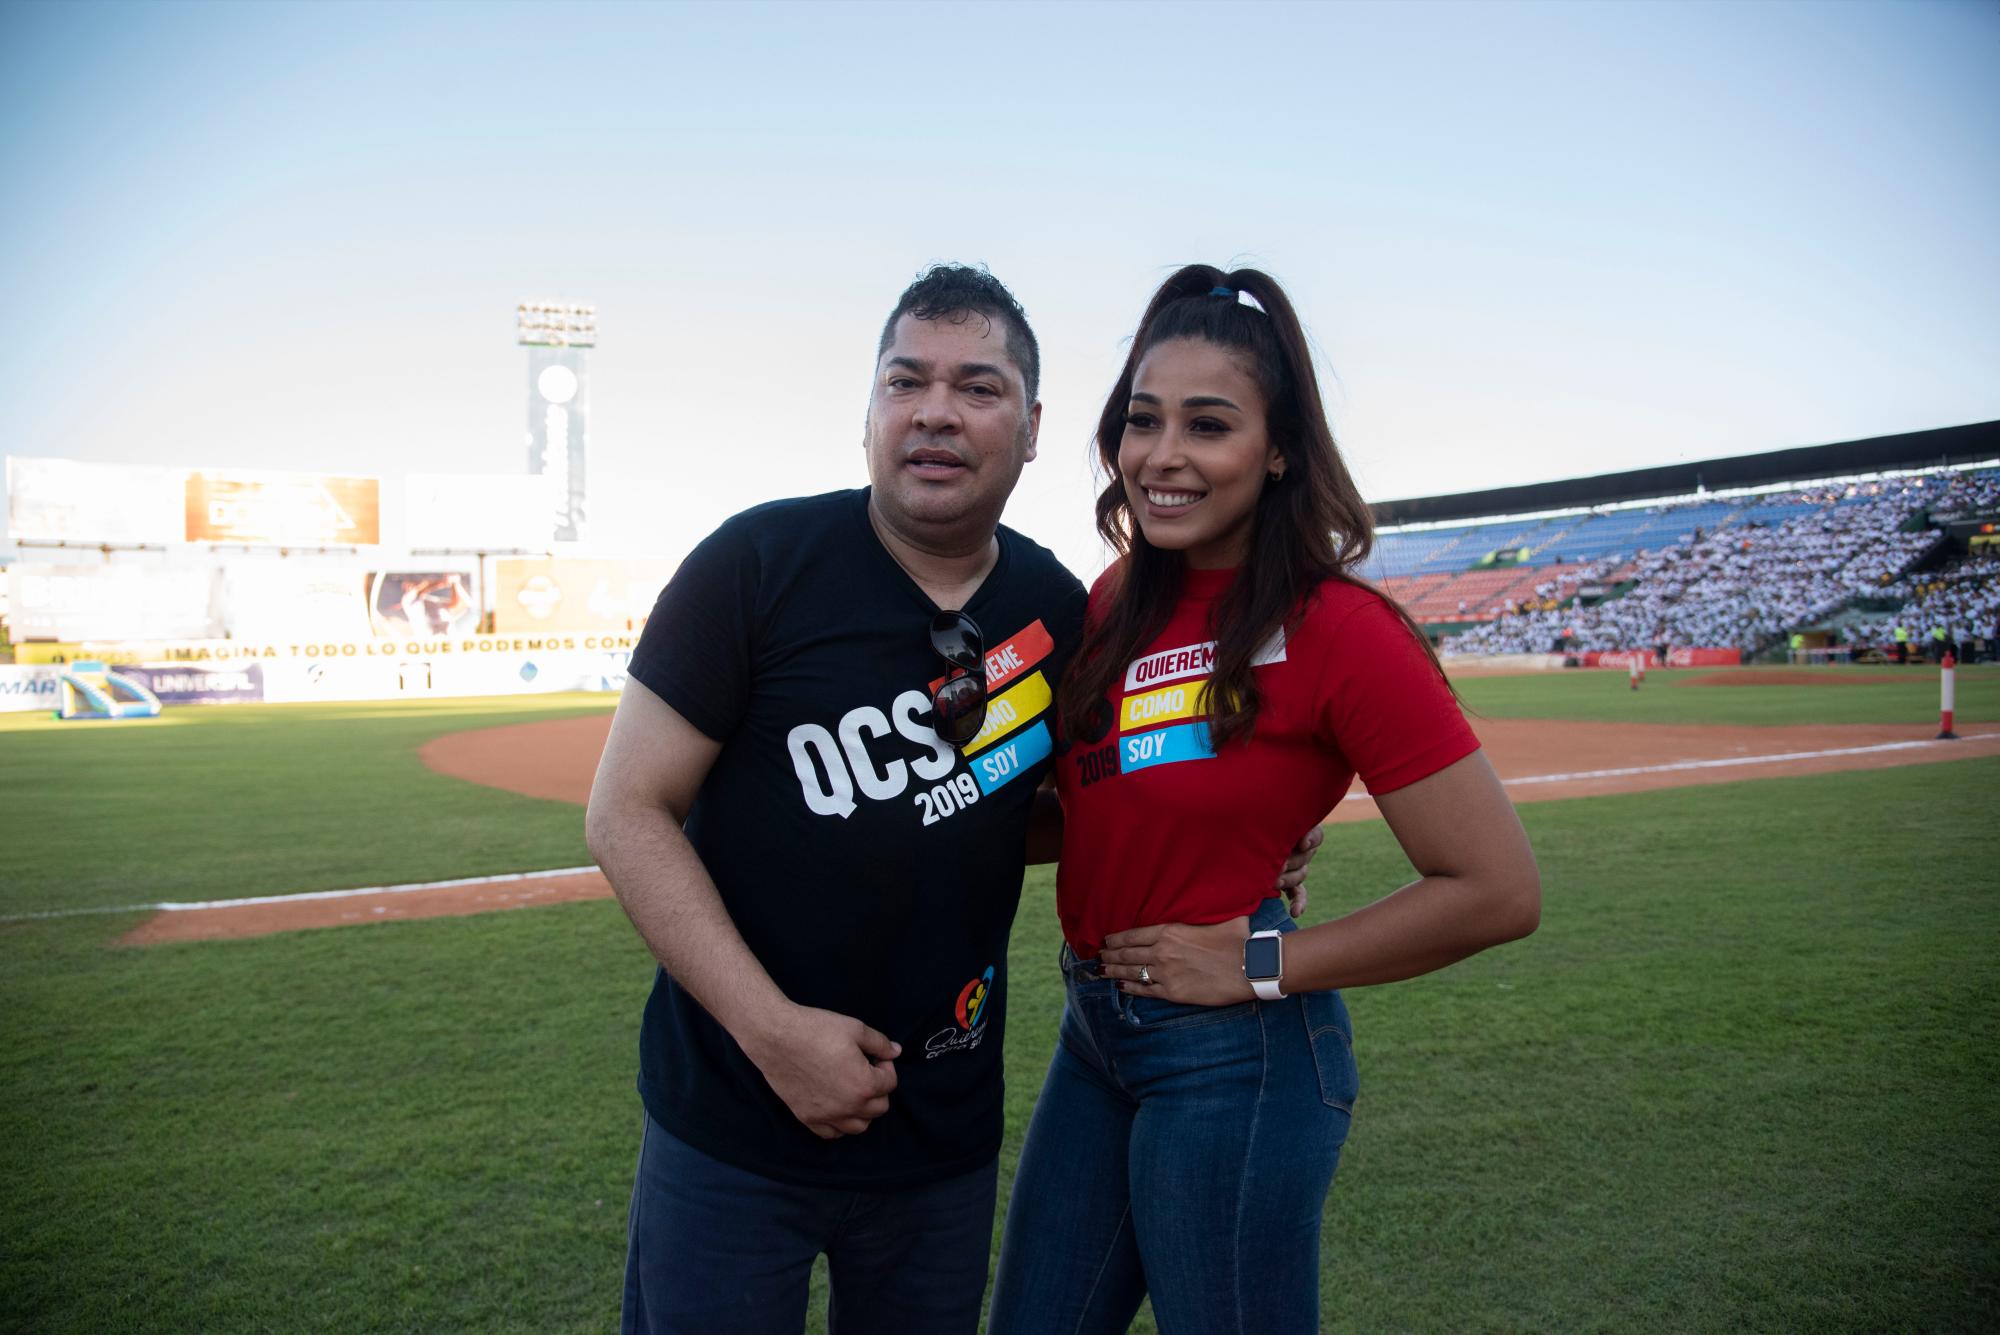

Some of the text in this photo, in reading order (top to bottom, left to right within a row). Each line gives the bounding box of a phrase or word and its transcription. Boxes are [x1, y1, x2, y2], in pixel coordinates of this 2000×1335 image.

[165, 636, 640, 661] IMAGINA TODO LO QUE PODEMOS CON
[1130, 689, 1185, 722] COMO
[787, 690, 955, 820] QCS
[982, 743, 1019, 783] SOY
[1076, 745, 1118, 788] 2019
[1127, 732, 1167, 763] SOY
[914, 772, 980, 827] 2019
